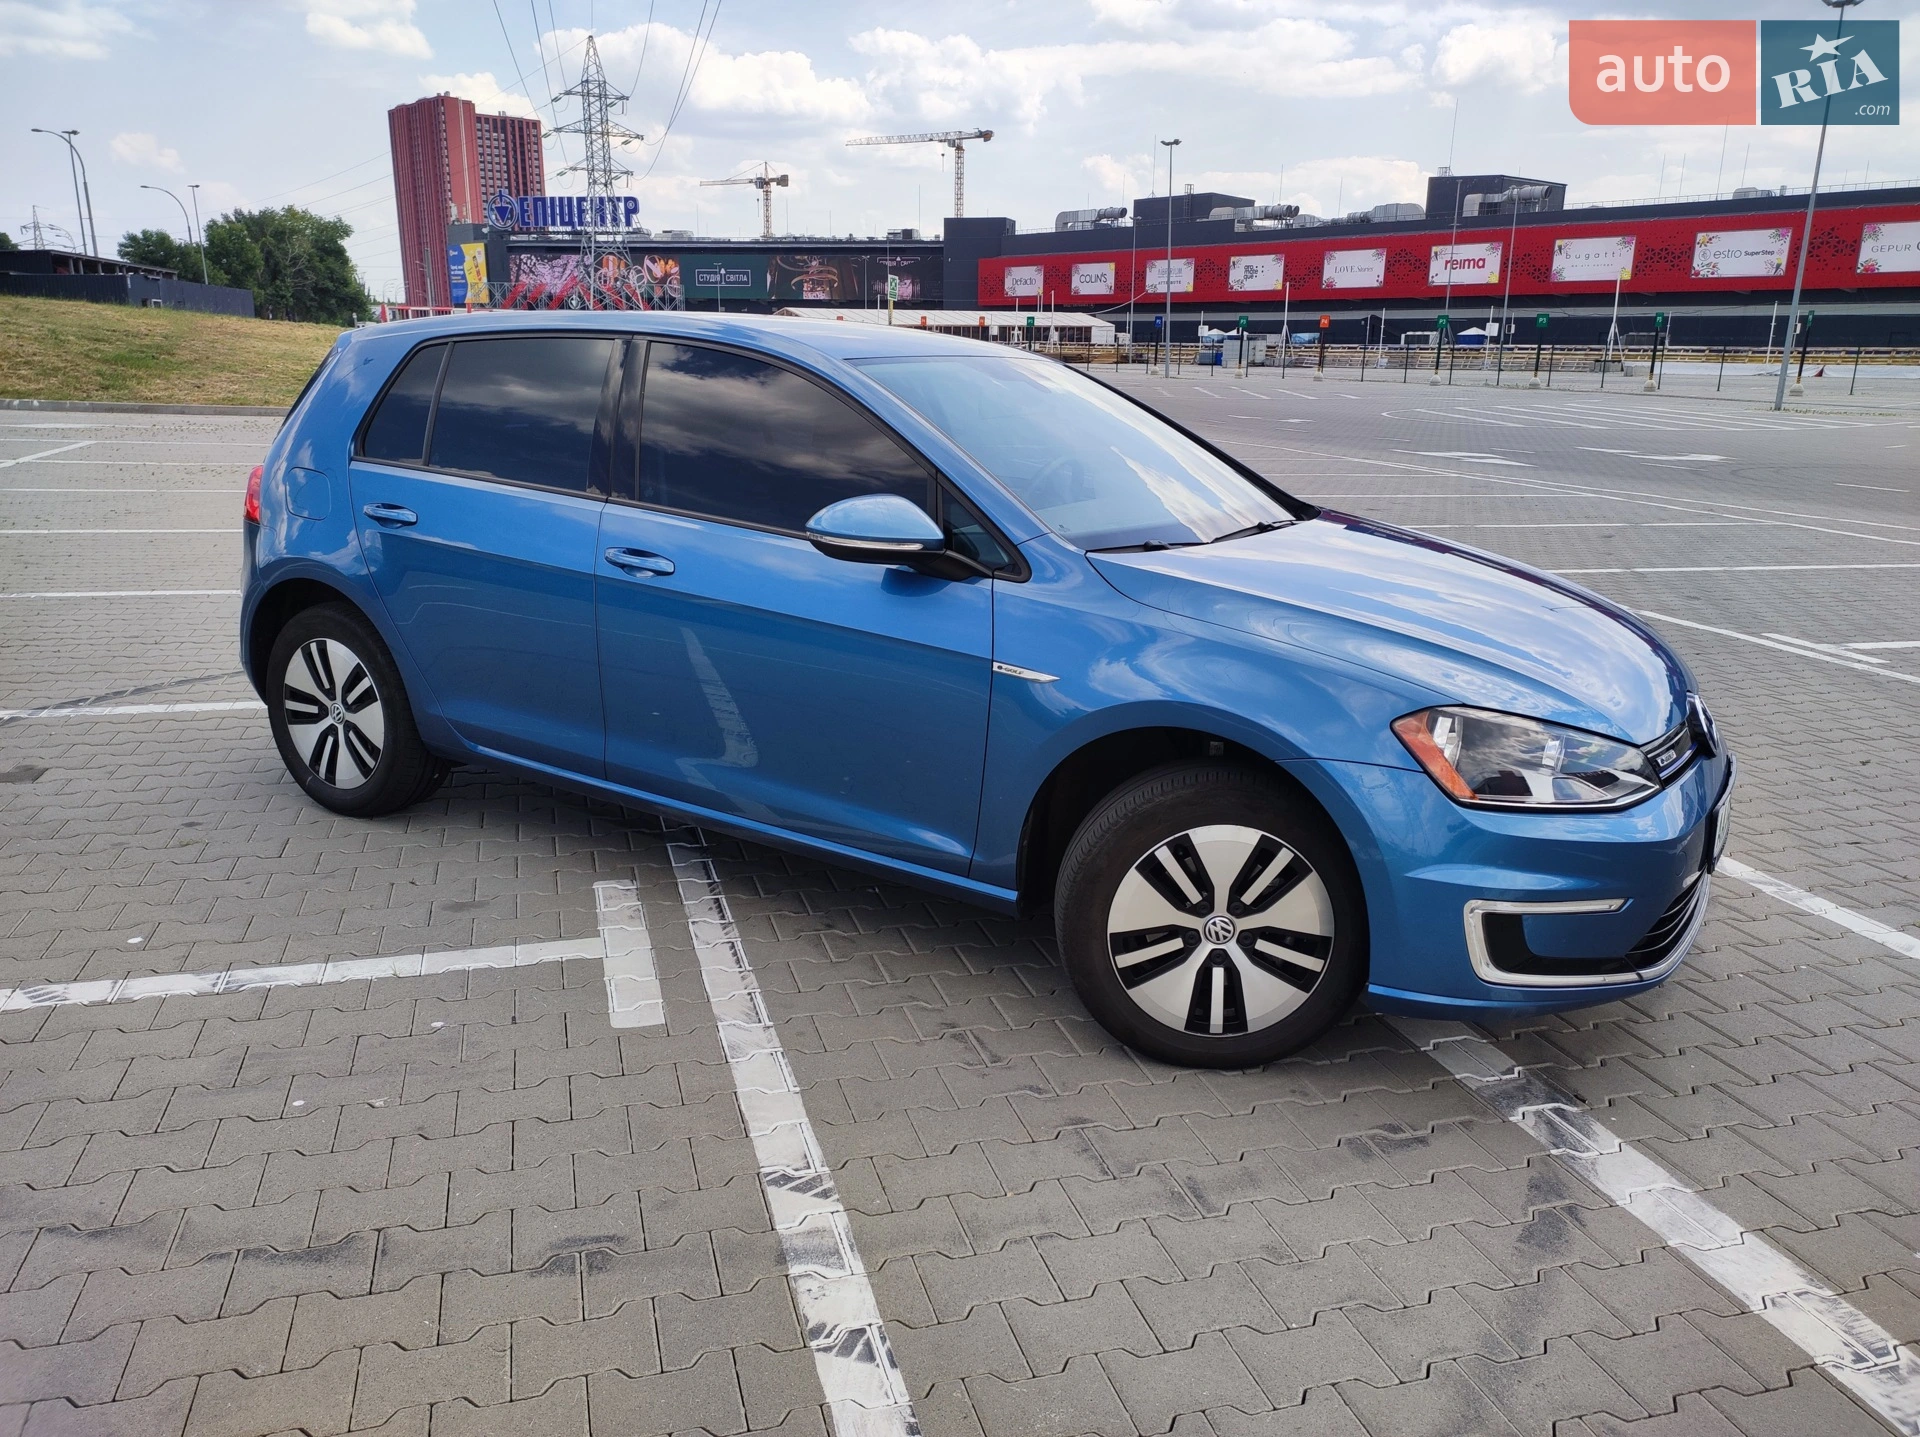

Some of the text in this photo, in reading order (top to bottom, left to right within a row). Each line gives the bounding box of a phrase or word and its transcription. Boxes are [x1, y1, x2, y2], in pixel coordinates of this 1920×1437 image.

[1871, 244, 1912, 253] GEPUR
[1565, 249, 1622, 260] bugatti
[1713, 249, 1742, 259] estro
[1444, 257, 1486, 270] reima
[698, 274, 748, 282] СТУДІЯ СВІТЛА
[1012, 277, 1037, 286] DeFacto
[1079, 272, 1108, 284] COLIN'S
